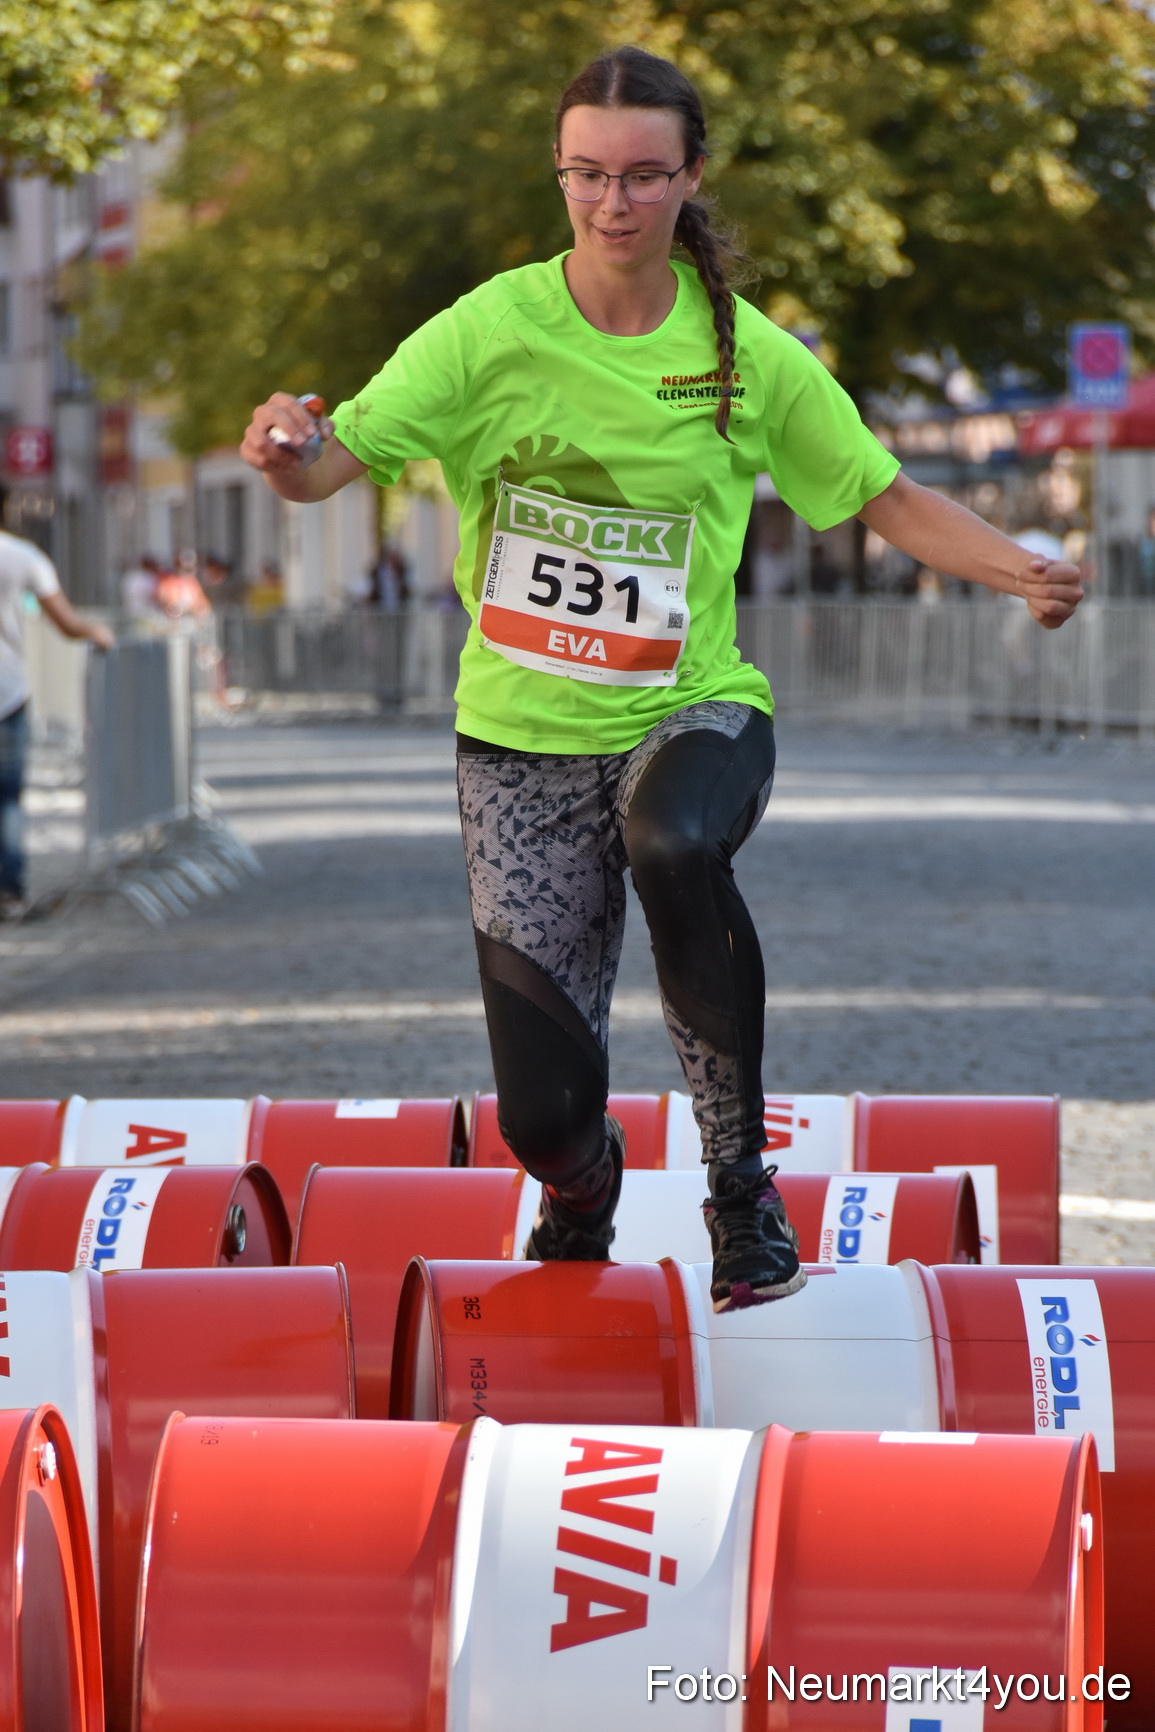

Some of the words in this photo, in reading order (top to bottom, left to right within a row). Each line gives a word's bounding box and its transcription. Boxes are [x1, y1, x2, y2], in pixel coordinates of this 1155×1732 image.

[661, 372, 741, 386] NEUMARKR
[509, 493, 675, 562] BOCK
[527, 552, 640, 624] 531
[547, 629, 608, 662] EVA
[463, 1296, 482, 1320] 362
[470, 1358, 488, 1420] M334/
